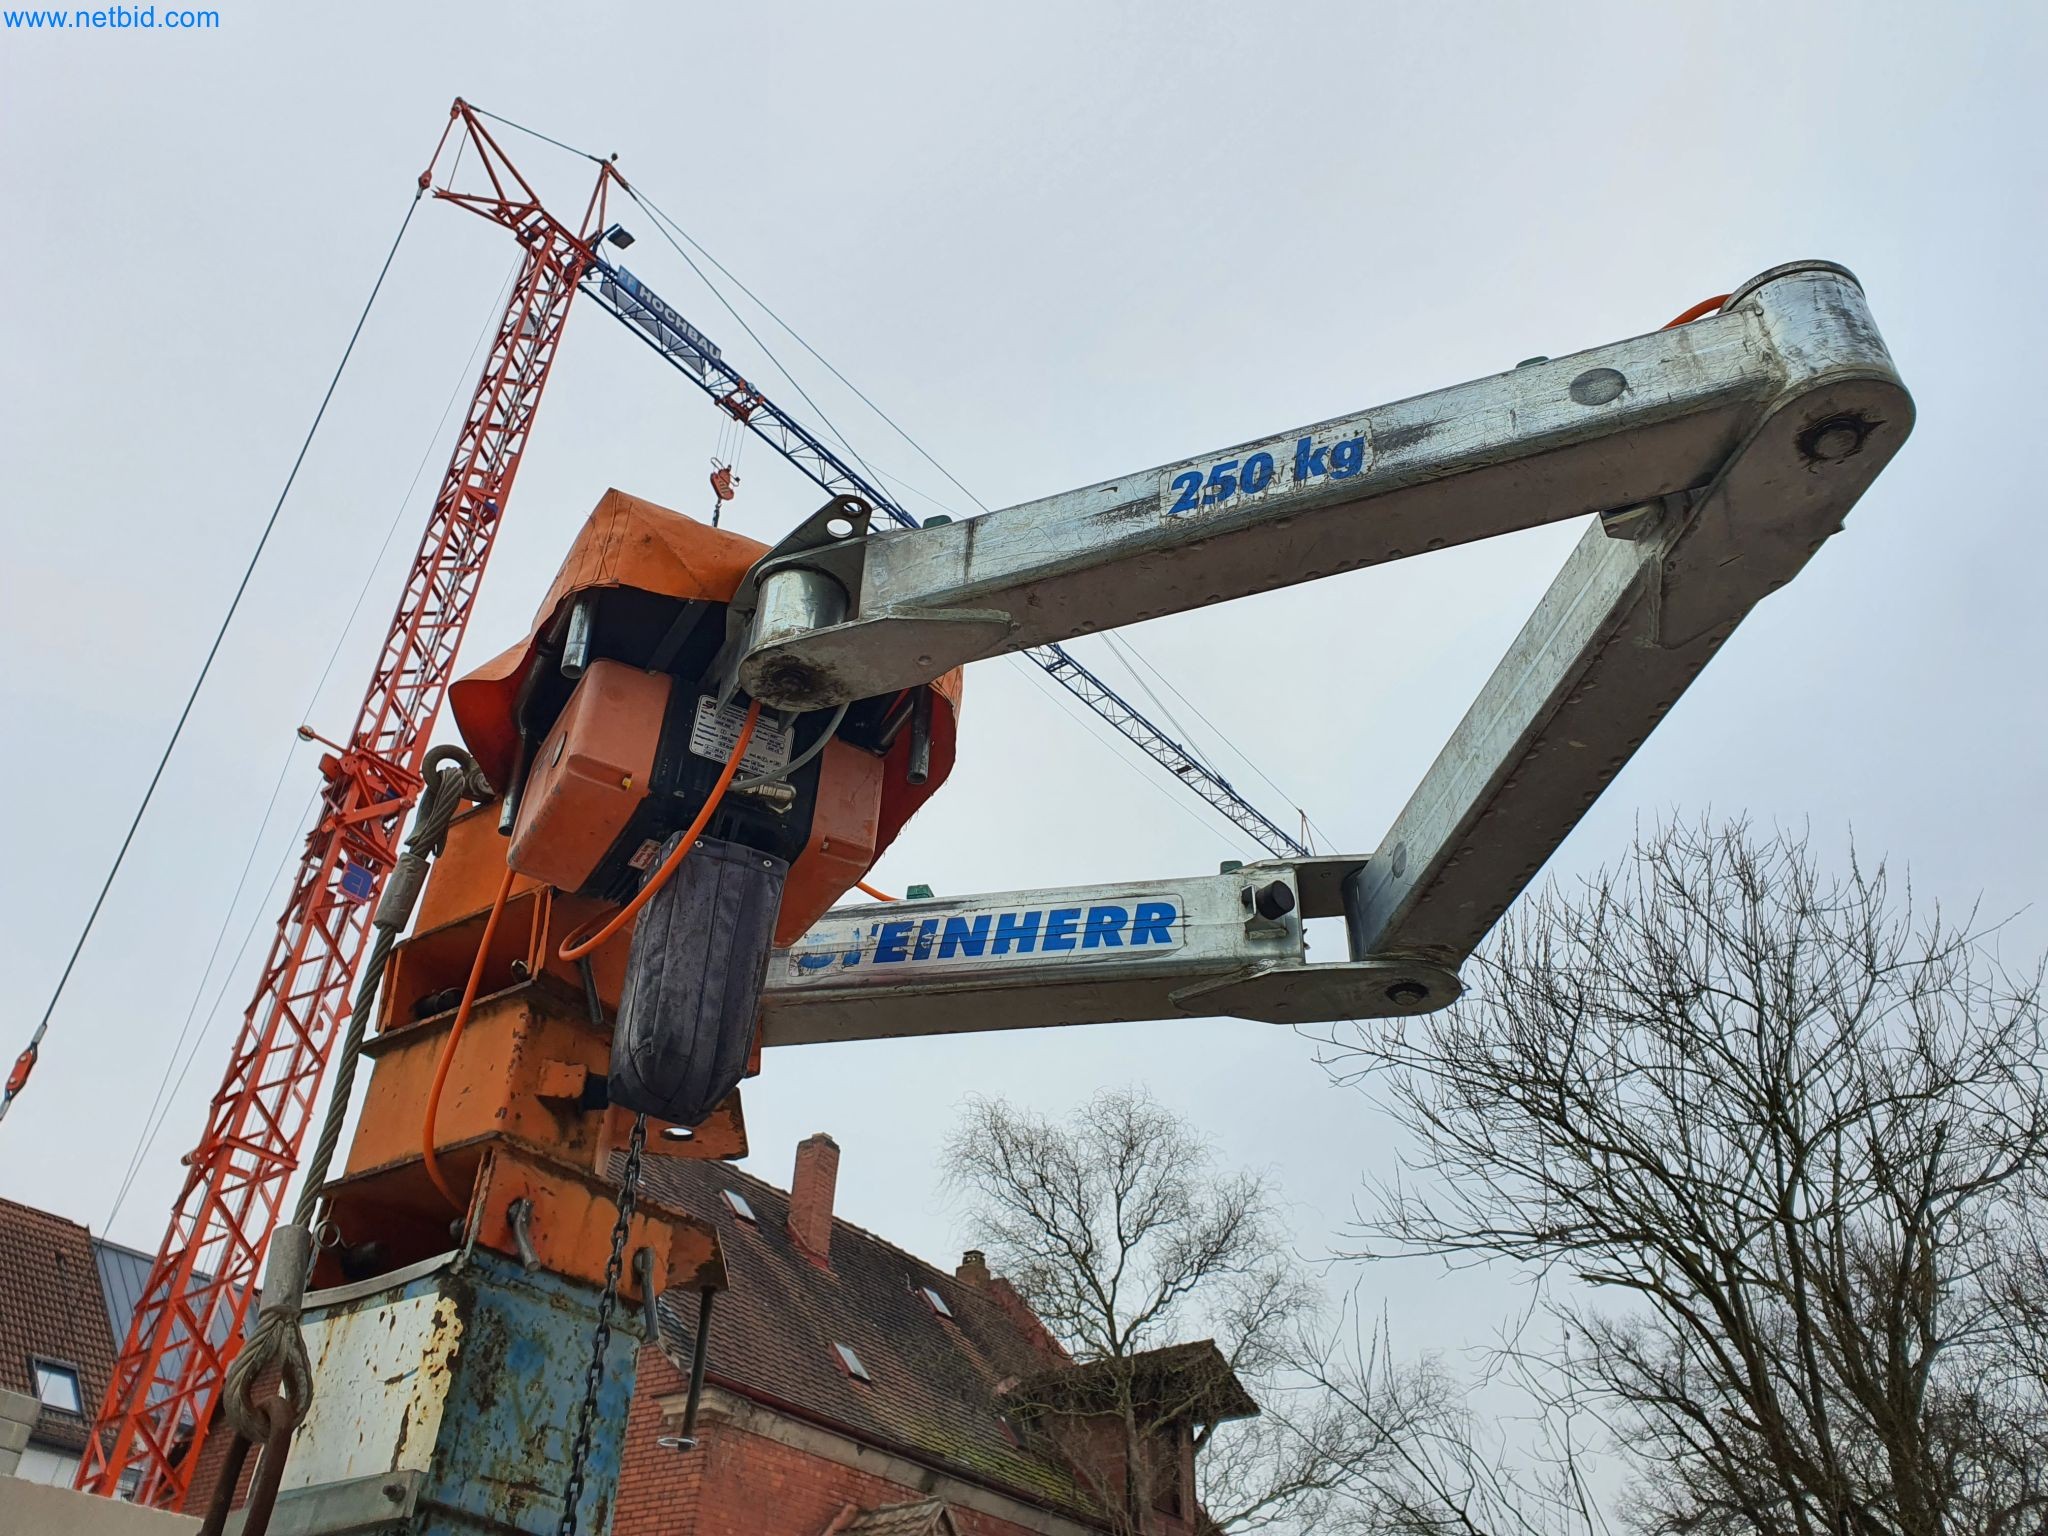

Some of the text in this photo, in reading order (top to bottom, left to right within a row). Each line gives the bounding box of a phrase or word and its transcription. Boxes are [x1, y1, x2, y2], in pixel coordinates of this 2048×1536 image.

[639, 285, 721, 360] HOCHBAU
[1168, 436, 1365, 515] 250 kg
